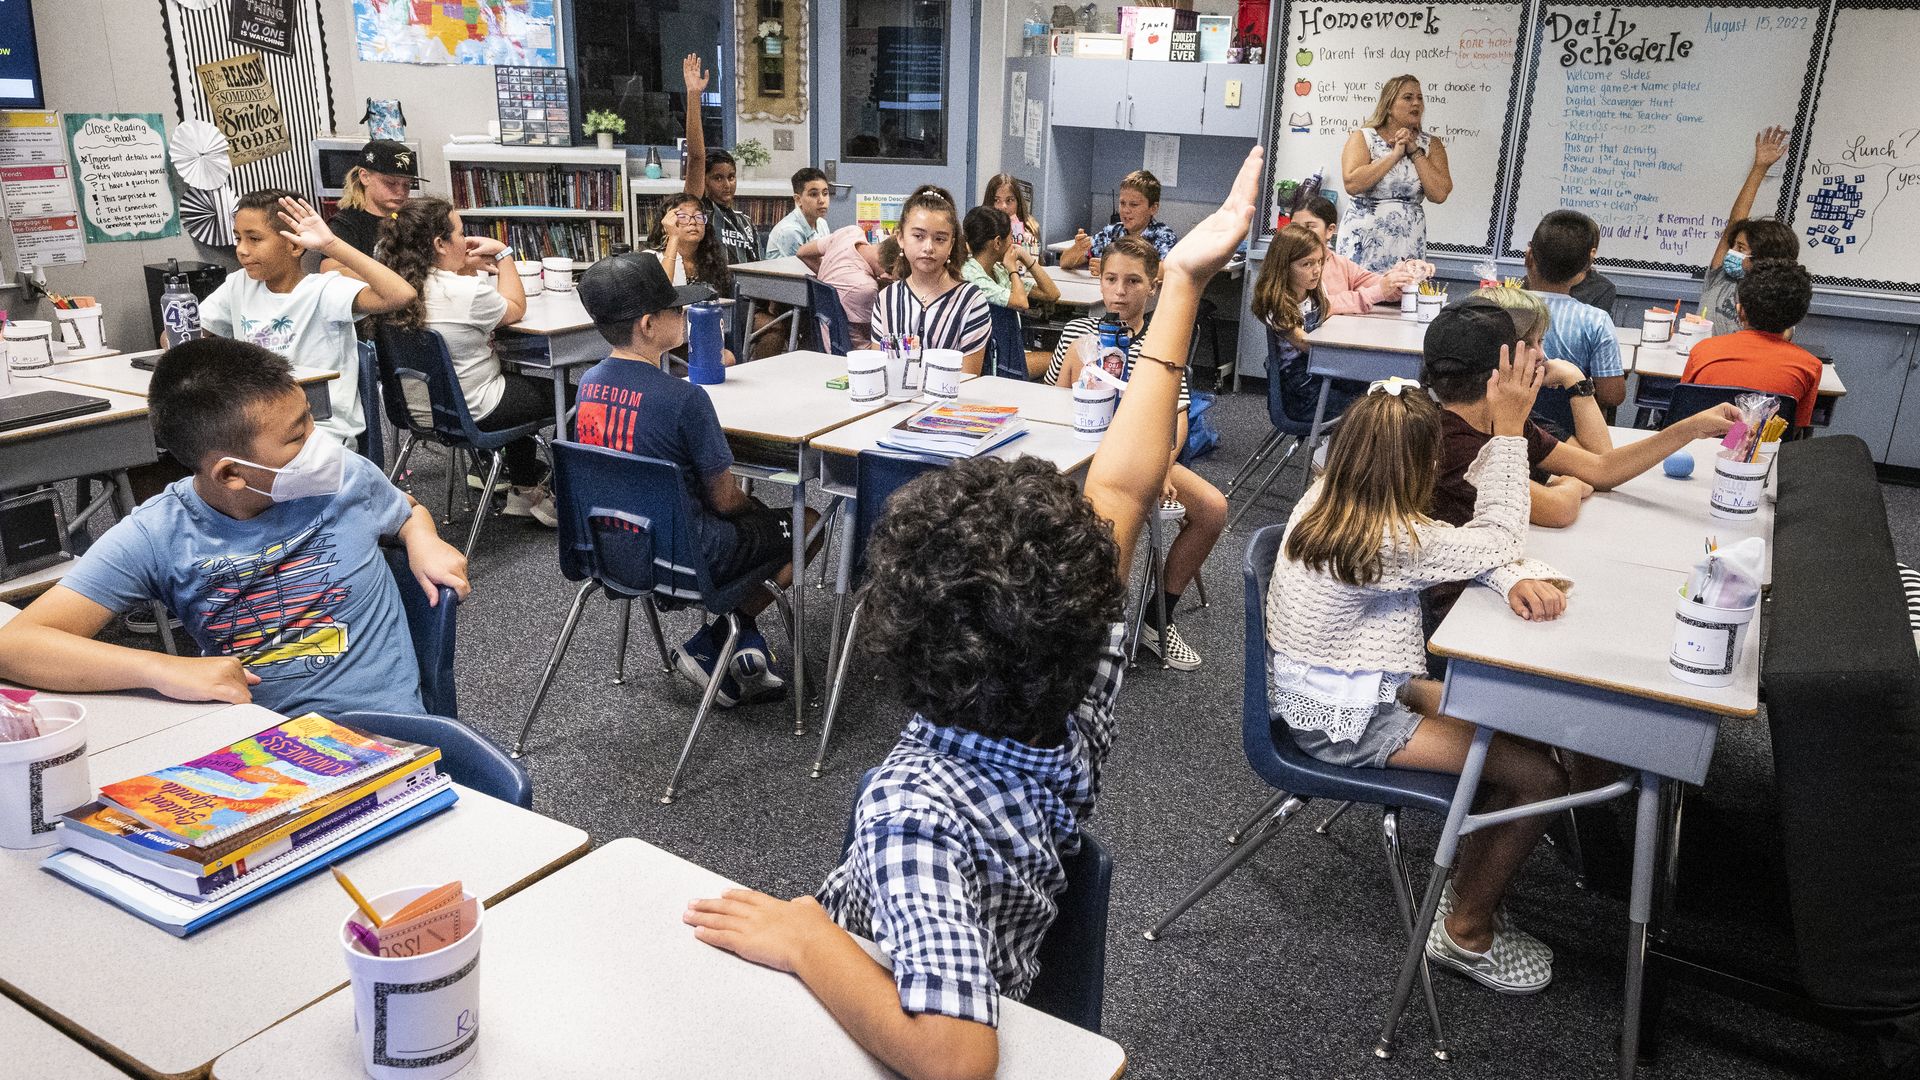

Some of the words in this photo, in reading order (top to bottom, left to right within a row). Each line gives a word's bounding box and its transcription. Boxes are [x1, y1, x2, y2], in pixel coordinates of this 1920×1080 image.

[241, 20, 259, 33] NO
[262, 26, 285, 40] ONE
[1297, 6, 1441, 40] Homework
[1545, 7, 1636, 45] Daily
[1704, 11, 1747, 41] August
[249, 32, 285, 47] WATCHING
[1172, 32, 1197, 42] COOLEST
[1171, 51, 1195, 61] EVER
[1319, 47, 1355, 61] Parent
[1364, 46, 1385, 59] first
[1390, 47, 1410, 62] day
[1415, 46, 1450, 62] packet
[1560, 32, 1693, 67] Schedule
[202, 69, 219, 94] BE
[221, 58, 265, 88] REASON
[1566, 69, 1613, 81] Welcome
[1317, 80, 1336, 93] Get
[1343, 82, 1368, 94] your
[1428, 83, 1438, 91] or
[1444, 82, 1476, 92] choose
[1479, 82, 1492, 92] to
[1566, 84, 1596, 94] Name
[1600, 83, 1630, 97] game
[1640, 82, 1669, 91] Name
[1672, 81, 1701, 91] plates
[220, 89, 264, 103] SOMEONE
[1319, 93, 1349, 102] borrow
[1353, 94, 1377, 103] them
[1565, 97, 1596, 109] Digital
[1600, 96, 1643, 109] Scavenger
[1650, 98, 1675, 108] Hunt
[223, 103, 279, 138] Smiles
[1562, 109, 1616, 121] Investigate
[1620, 110, 1632, 119] the
[1636, 110, 1671, 120] Teacher
[85, 122, 112, 136] Close
[113, 123, 147, 134] Reading
[1320, 116, 1348, 132] Bring
[1320, 127, 1336, 135] one
[1446, 124, 1480, 137] borrow
[105, 135, 137, 144] Symbols
[228, 125, 285, 153] TODAY
[1564, 143, 1581, 152] This
[1600, 145, 1619, 153] that
[1623, 145, 1657, 160] activity
[87, 153, 123, 165] Important
[1564, 153, 1594, 163] Review
[1613, 158, 1630, 169] day
[97, 173, 111, 181] Key
[1593, 166, 1616, 175] about
[101, 184, 106, 192] I
[131, 179, 160, 188] question
[1560, 186, 1584, 194] MPR
[102, 195, 116, 203] This
[118, 192, 147, 202] surprised
[1560, 197, 1601, 208] Planners
[125, 203, 157, 212] connection
[96, 217, 111, 225] Use
[133, 212, 160, 221] symbols
[105, 221, 131, 229] annotate
[1667, 214, 1704, 226] Remind
[1617, 225, 1632, 238] did
[1655, 226, 1678, 238] have
[1681, 226, 1708, 239] after
[1659, 239, 1688, 255] duty!
[582, 383, 643, 407] FREEDOM
[260, 736, 350, 776] KINDNESS
[161, 781, 218, 809] Agenda
[140, 792, 206, 825] Student
[298, 824, 321, 839] Student
[144, 831, 190, 850] CALIFORNIA
